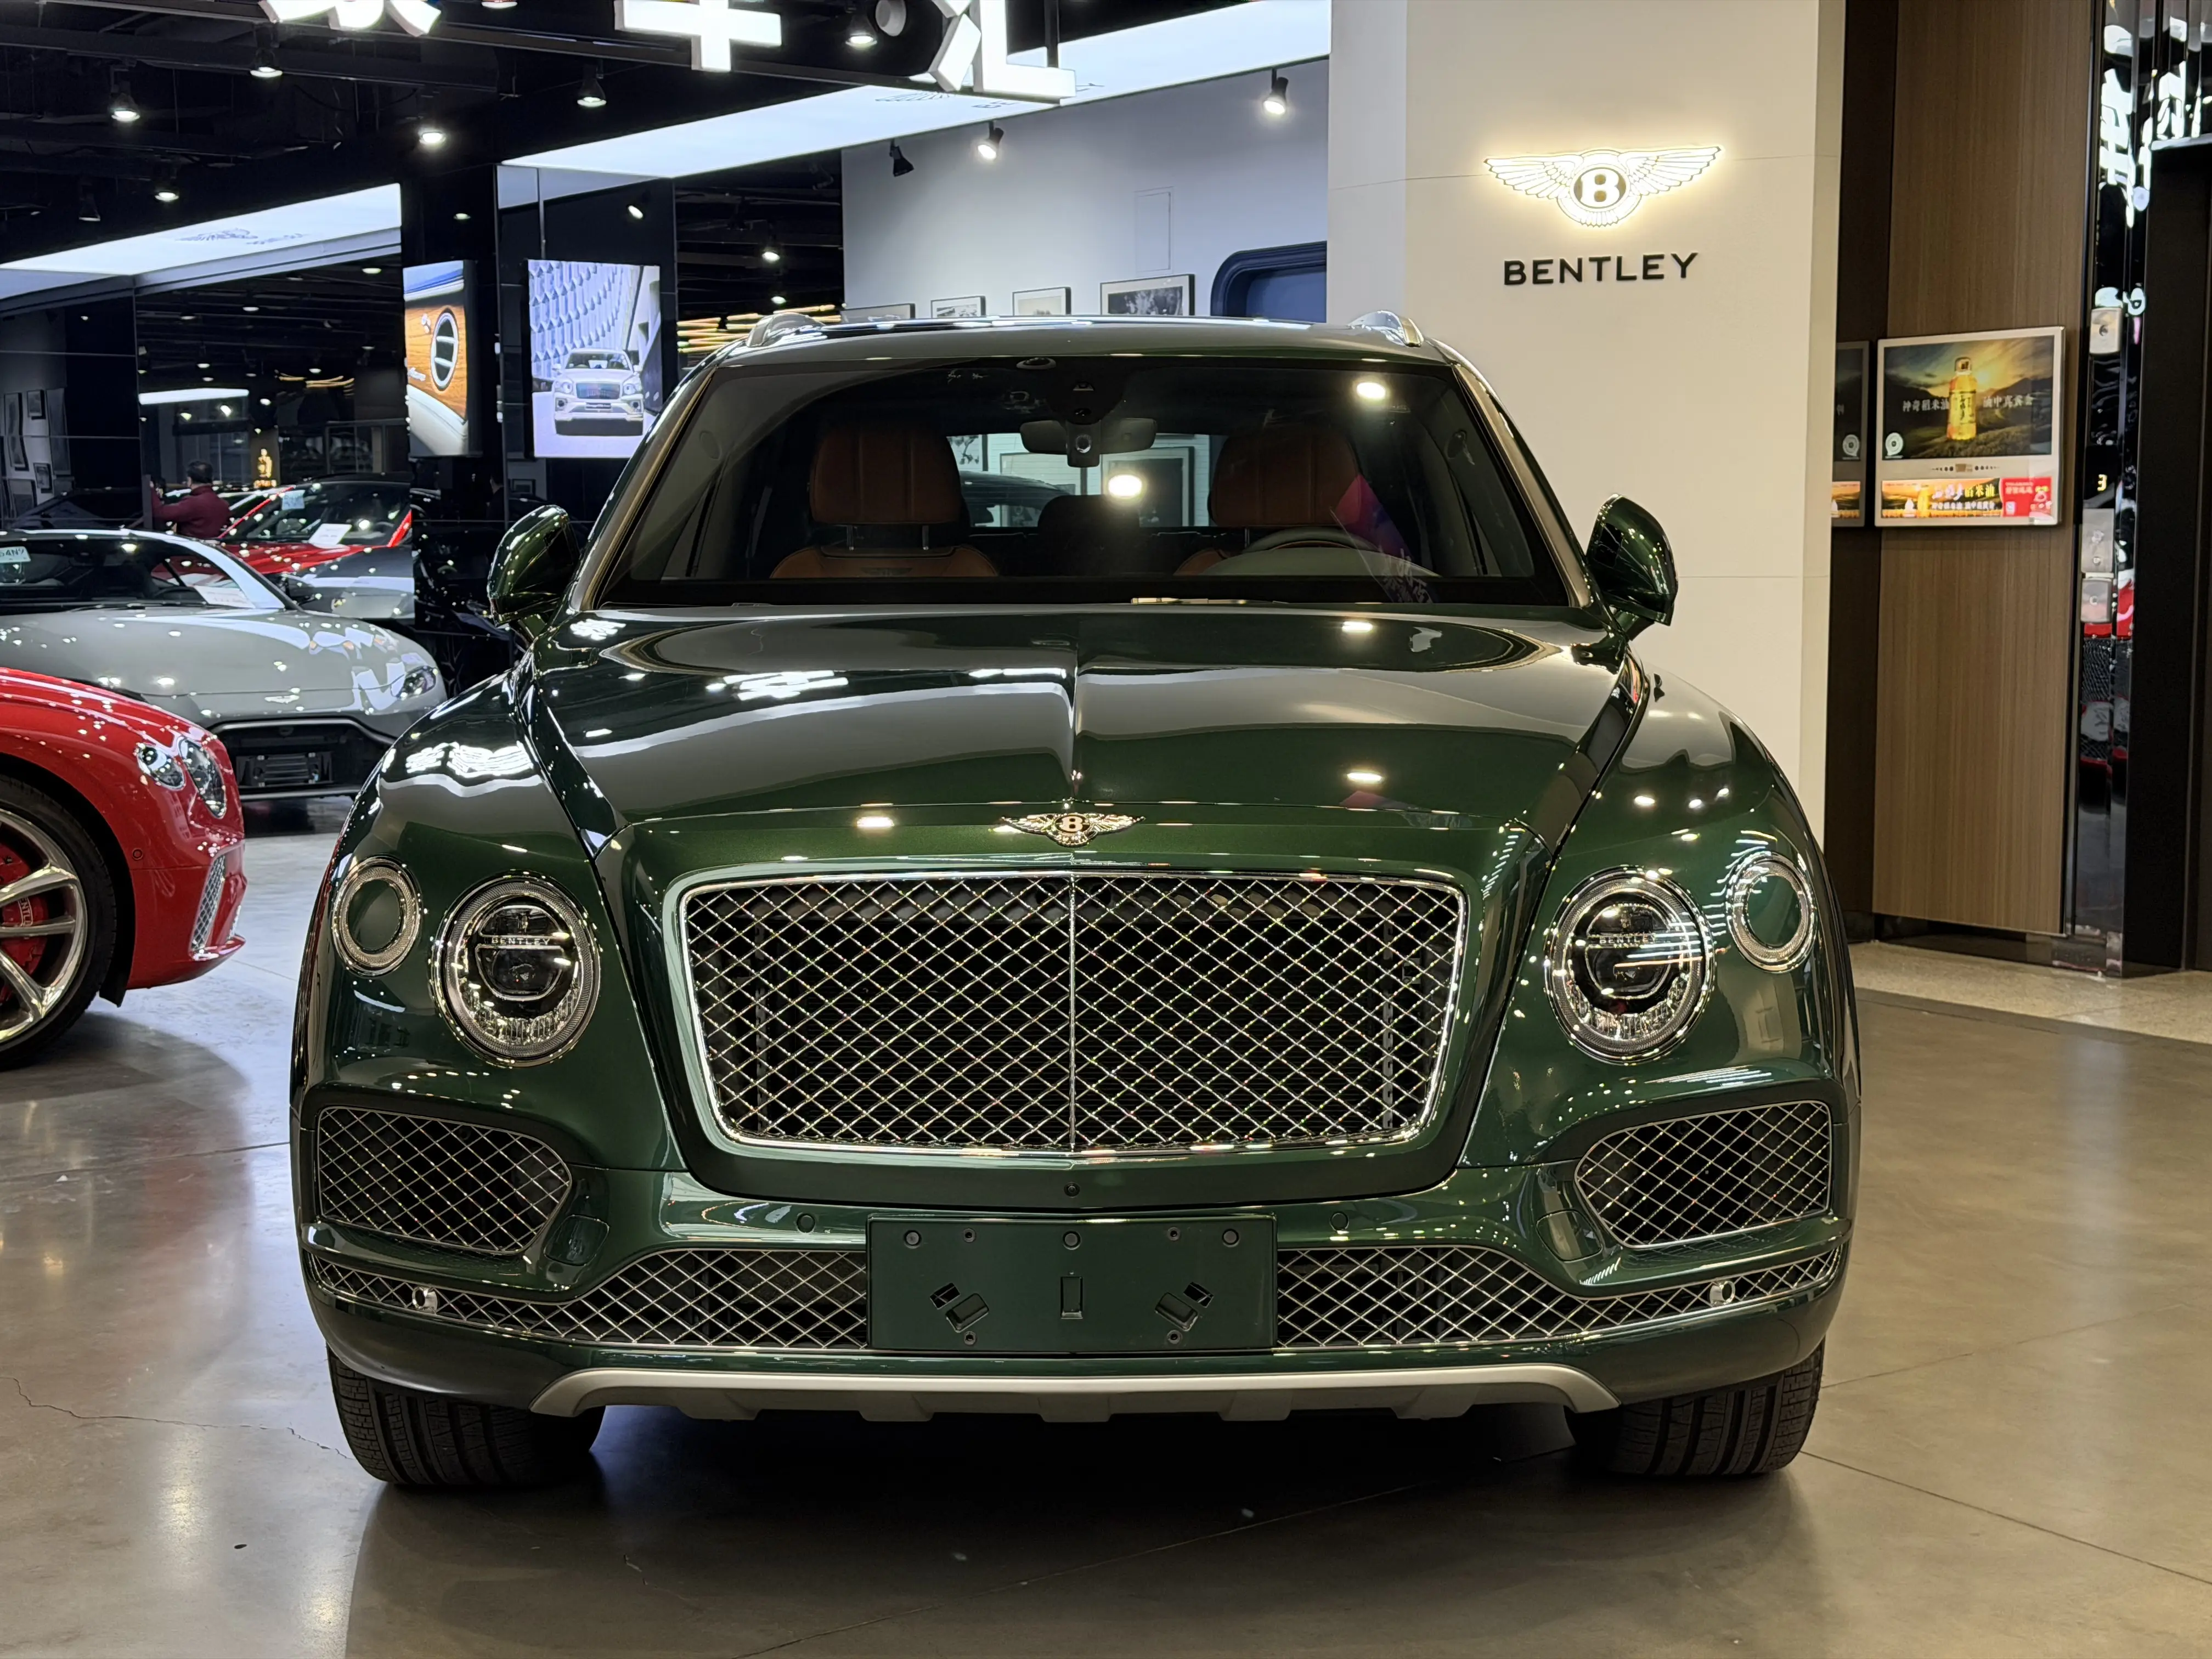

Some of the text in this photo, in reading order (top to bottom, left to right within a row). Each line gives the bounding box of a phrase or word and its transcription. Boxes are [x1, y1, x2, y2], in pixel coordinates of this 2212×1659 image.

[1503, 252, 1699, 285] BENTLEY
[2097, 474, 2108, 492] 3
[491, 936, 550, 945] BENTLEY
